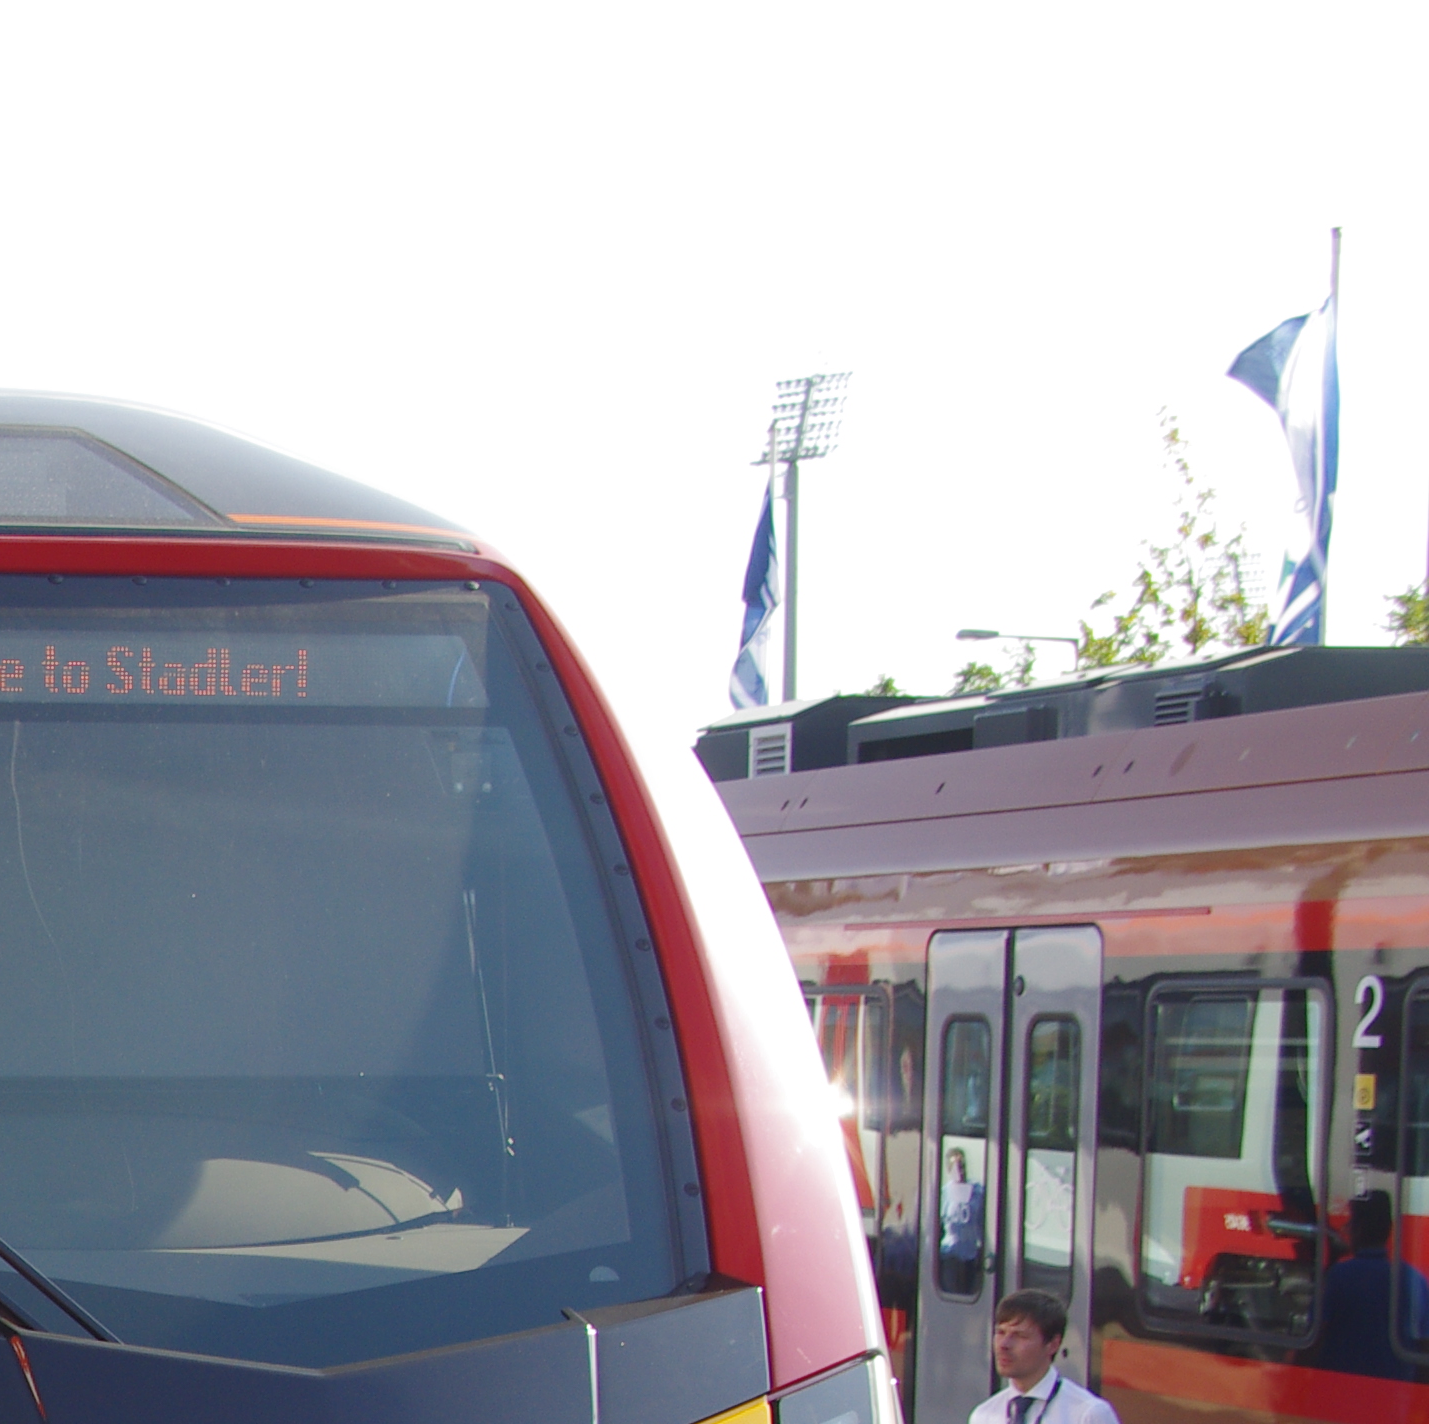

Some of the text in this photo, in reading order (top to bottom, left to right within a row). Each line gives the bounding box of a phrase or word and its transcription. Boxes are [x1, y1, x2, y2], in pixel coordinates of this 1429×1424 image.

[43, 644, 90, 694] to
[106, 645, 308, 698] Stadler!
[1351, 974, 1384, 1048] 2
